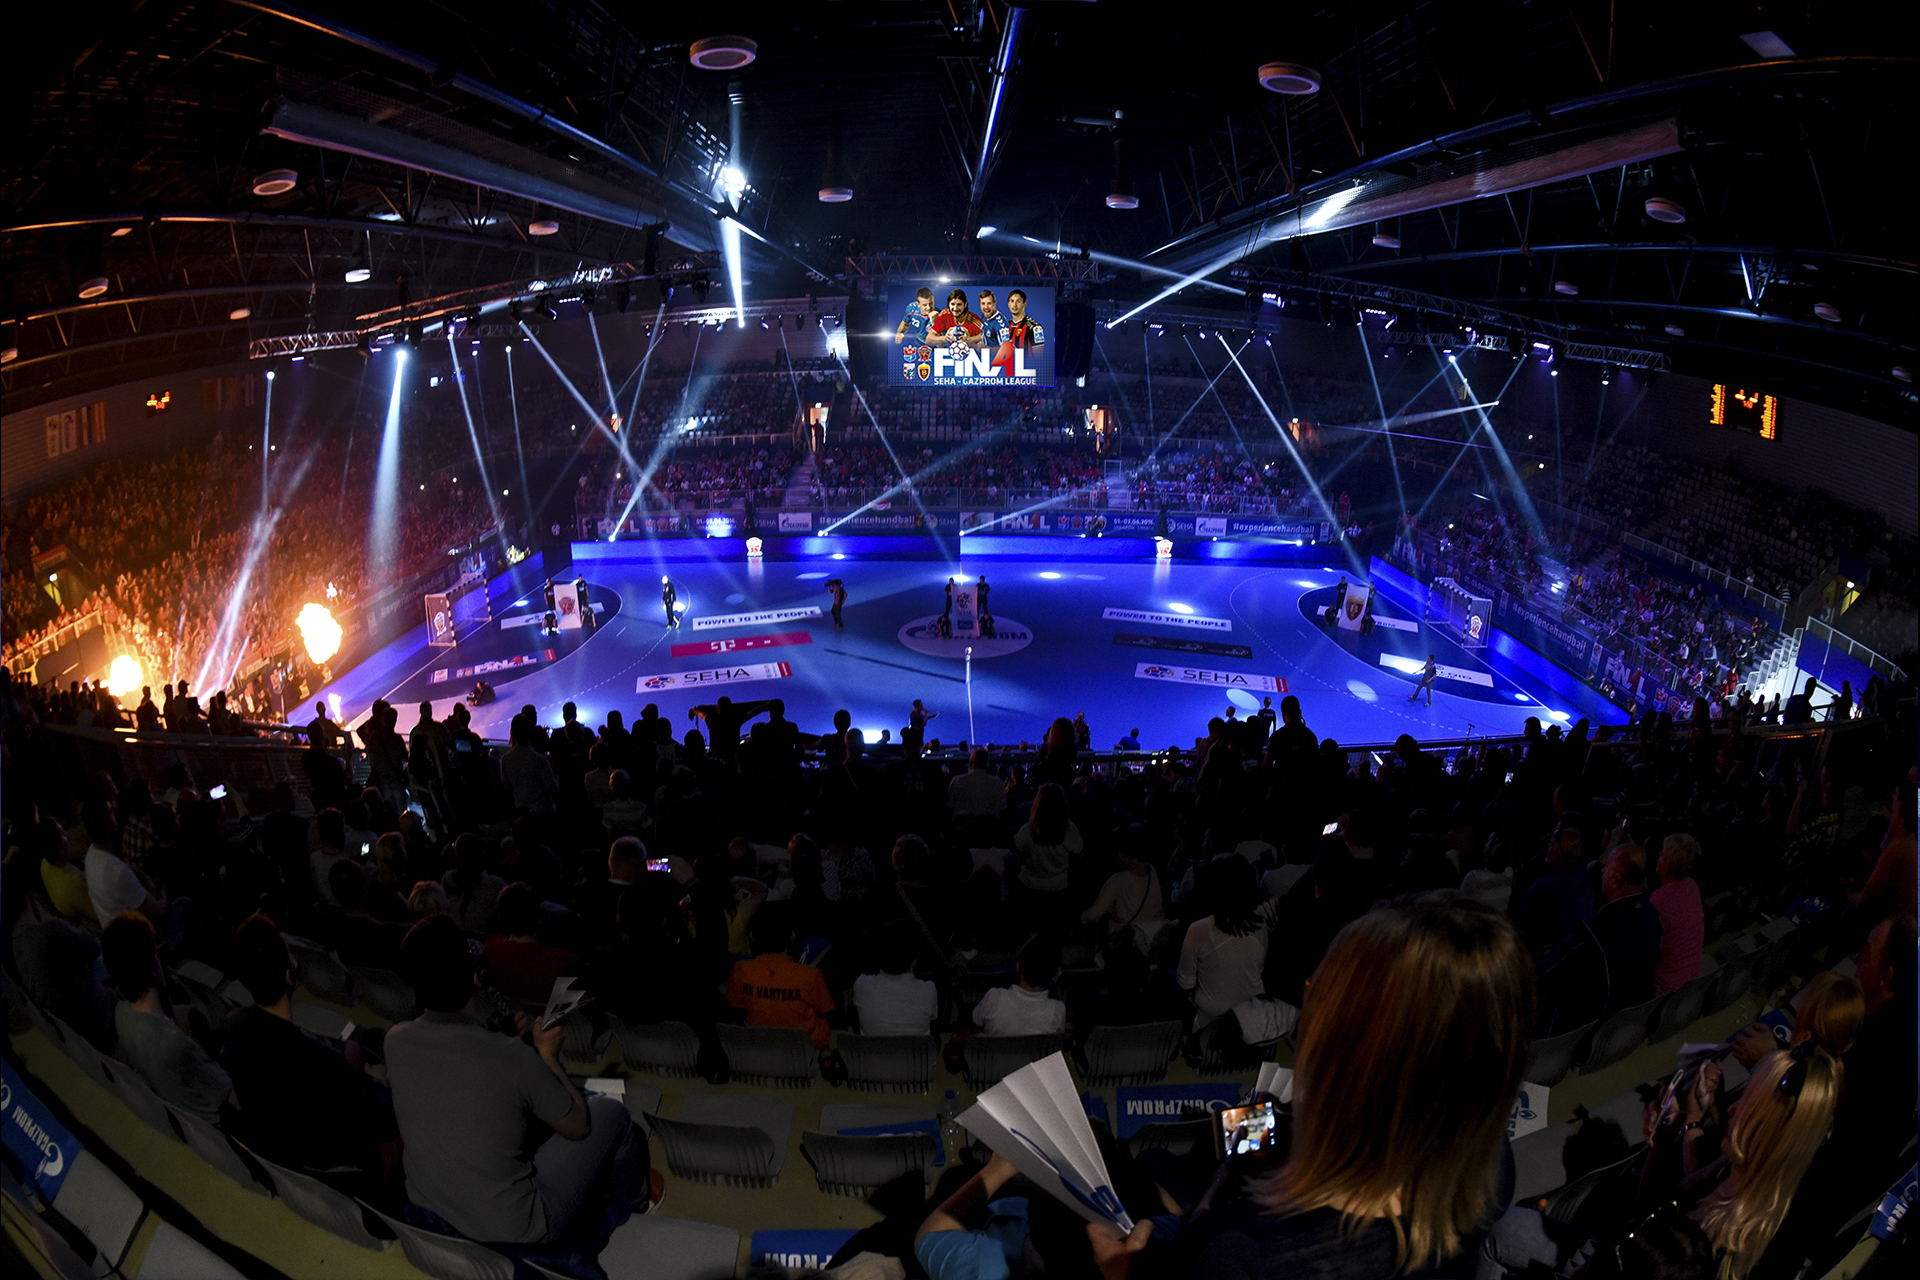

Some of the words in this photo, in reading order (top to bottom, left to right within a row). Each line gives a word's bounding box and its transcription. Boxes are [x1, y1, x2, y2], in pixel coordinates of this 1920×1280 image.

[934, 377, 956, 385] SEHA
[962, 377, 1003, 385] GAZPROM
[1005, 377, 1037, 385] LEAGUE
[1176, 522, 1194, 530] SEHA
[1233, 522, 1315, 534] #experiencehandball
[697, 616, 736, 627] POWER
[739, 615, 752, 623] TO
[753, 612, 774, 621] THE
[776, 608, 817, 619] PEOPLE
[1108, 610, 1147, 620] POWER
[1166, 616, 1185, 624] THE
[1187, 618, 1227, 628] PEOPLE
[684, 668, 750, 683] SEHA
[1184, 669, 1248, 685] SEHA
[756, 986, 801, 1001] VARTEKS
[1127, 1099, 1206, 1115] GAZPROM
[12, 1105, 49, 1152] GAZPROM
